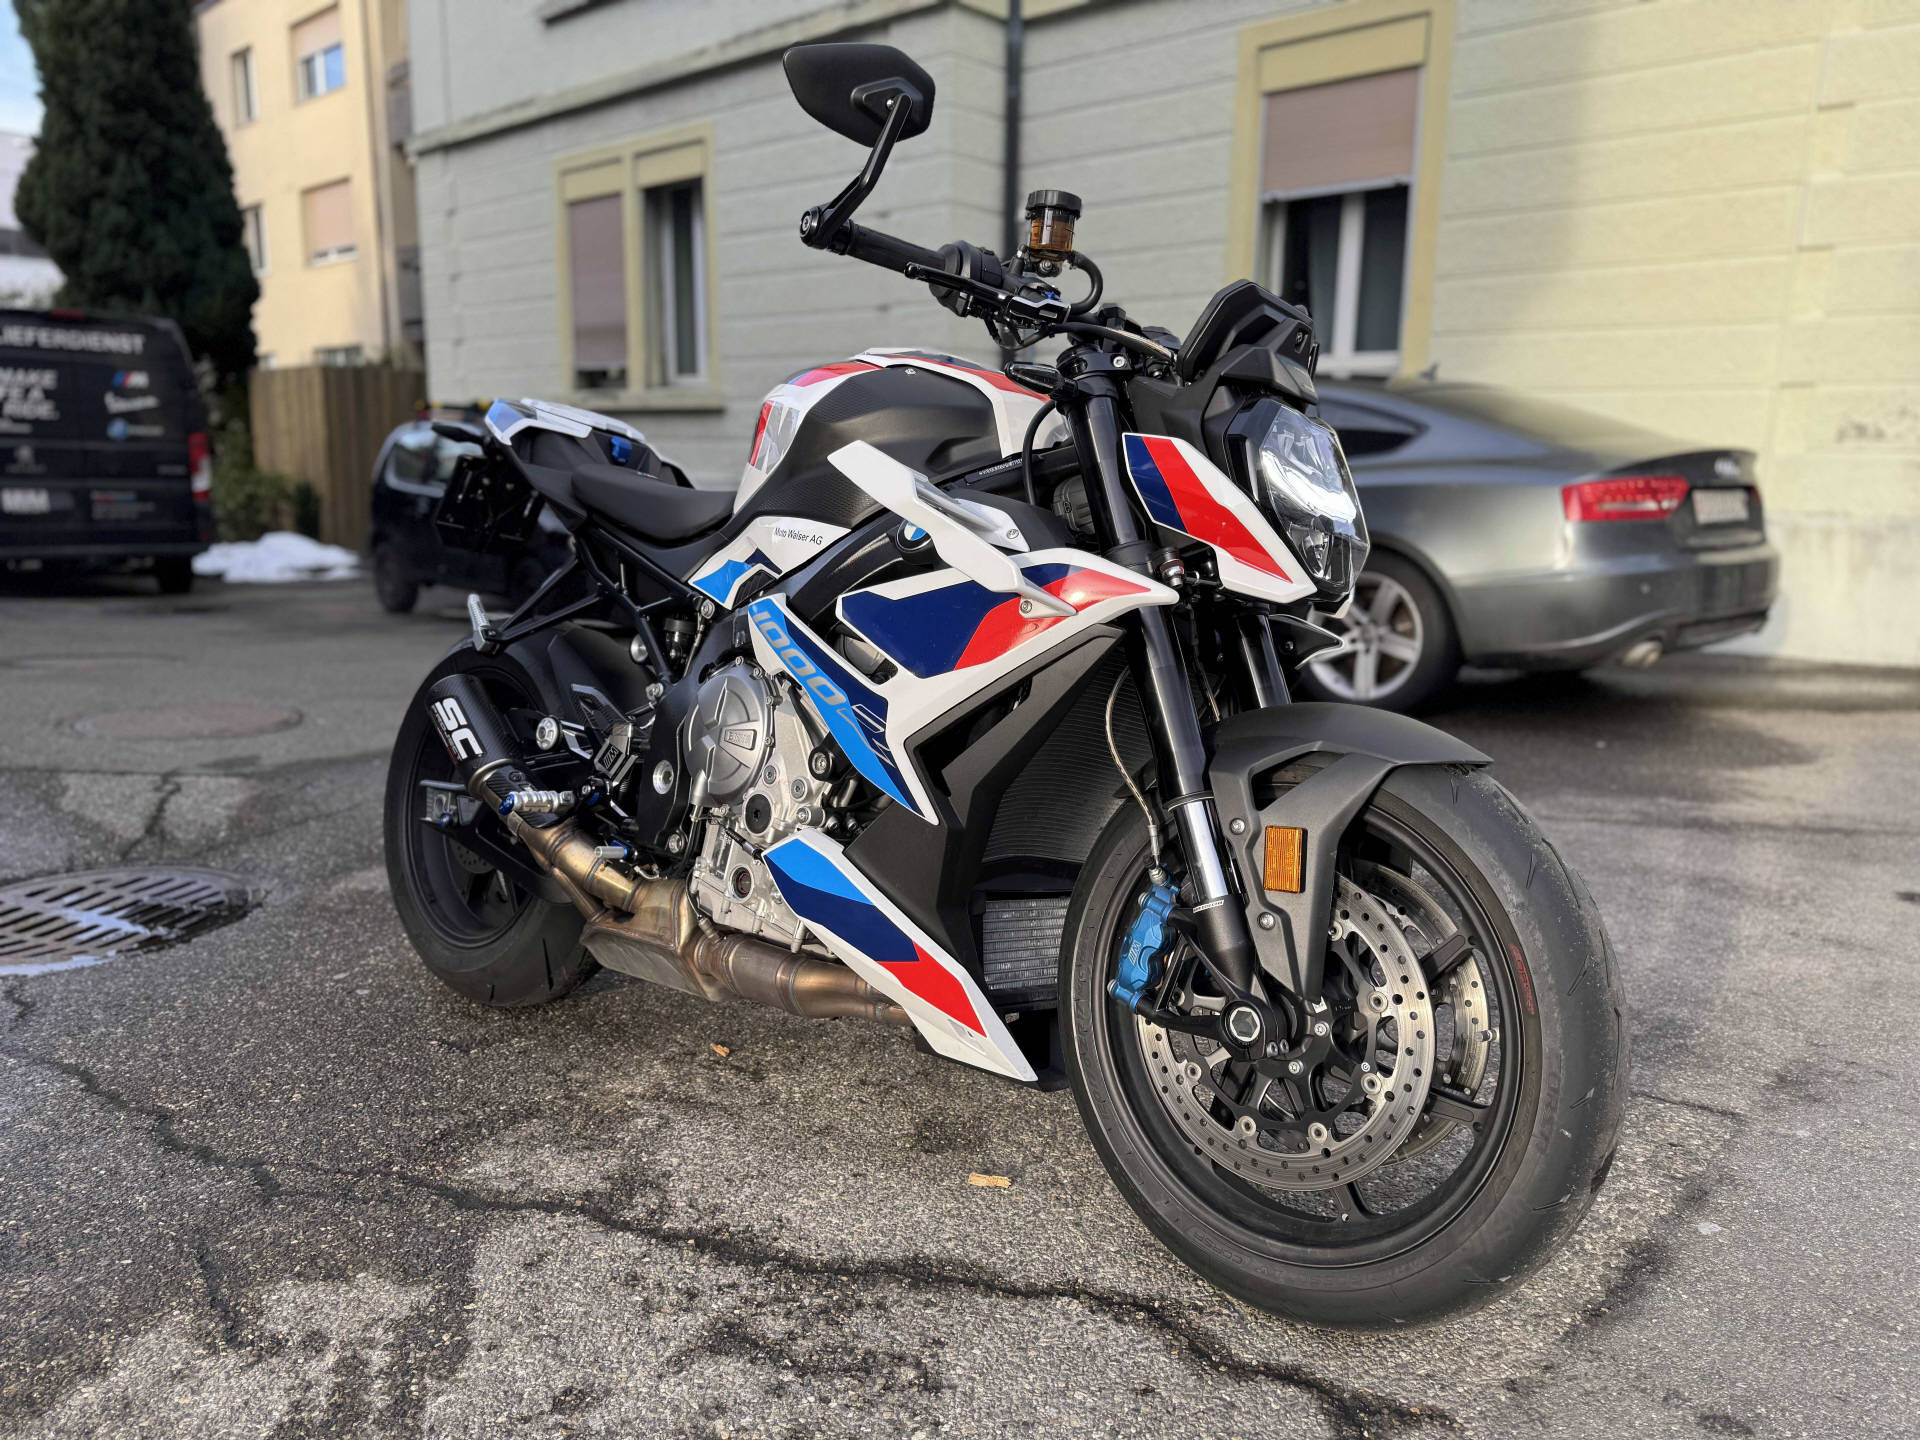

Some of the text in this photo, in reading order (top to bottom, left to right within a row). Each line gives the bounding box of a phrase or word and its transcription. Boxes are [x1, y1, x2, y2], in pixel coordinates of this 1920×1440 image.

[0, 325, 145, 354] IEFERDIENST
[788, 529, 809, 542] Walser
[810, 534, 824, 545] AG
[752, 611, 847, 705] 1000
[434, 697, 484, 760] SC
